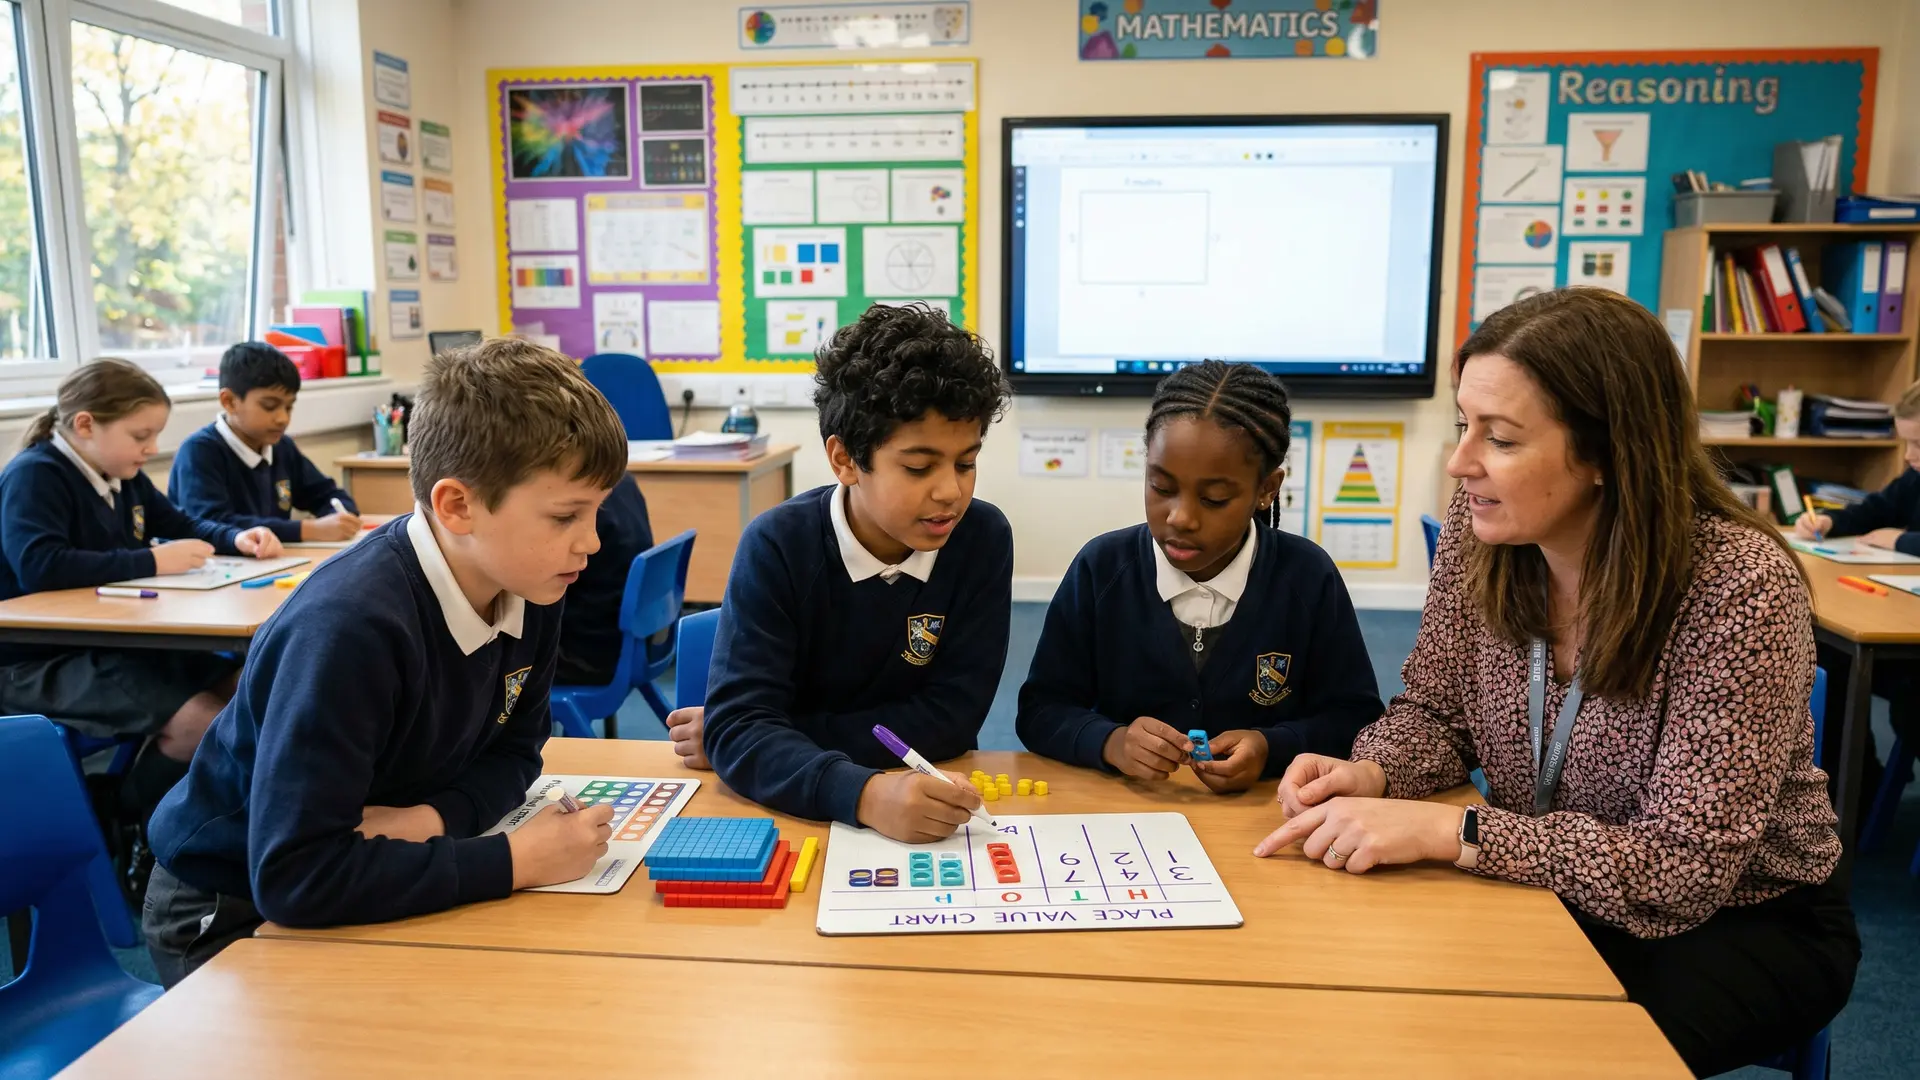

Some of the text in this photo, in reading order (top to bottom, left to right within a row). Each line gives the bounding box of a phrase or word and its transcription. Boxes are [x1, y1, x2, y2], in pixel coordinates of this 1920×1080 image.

[1116, 11, 1338, 40] MATHEMATICS
[1558, 67, 1779, 114] Reasoning
[1060, 852, 1081, 865] 9
[1110, 852, 1134, 864] 2
[1065, 866, 1194, 883] 3 4 7
[1070, 890, 1088, 901] T
[1127, 889, 1149, 900] H
[889, 908, 1174, 926] PLACE VALUE CHART
